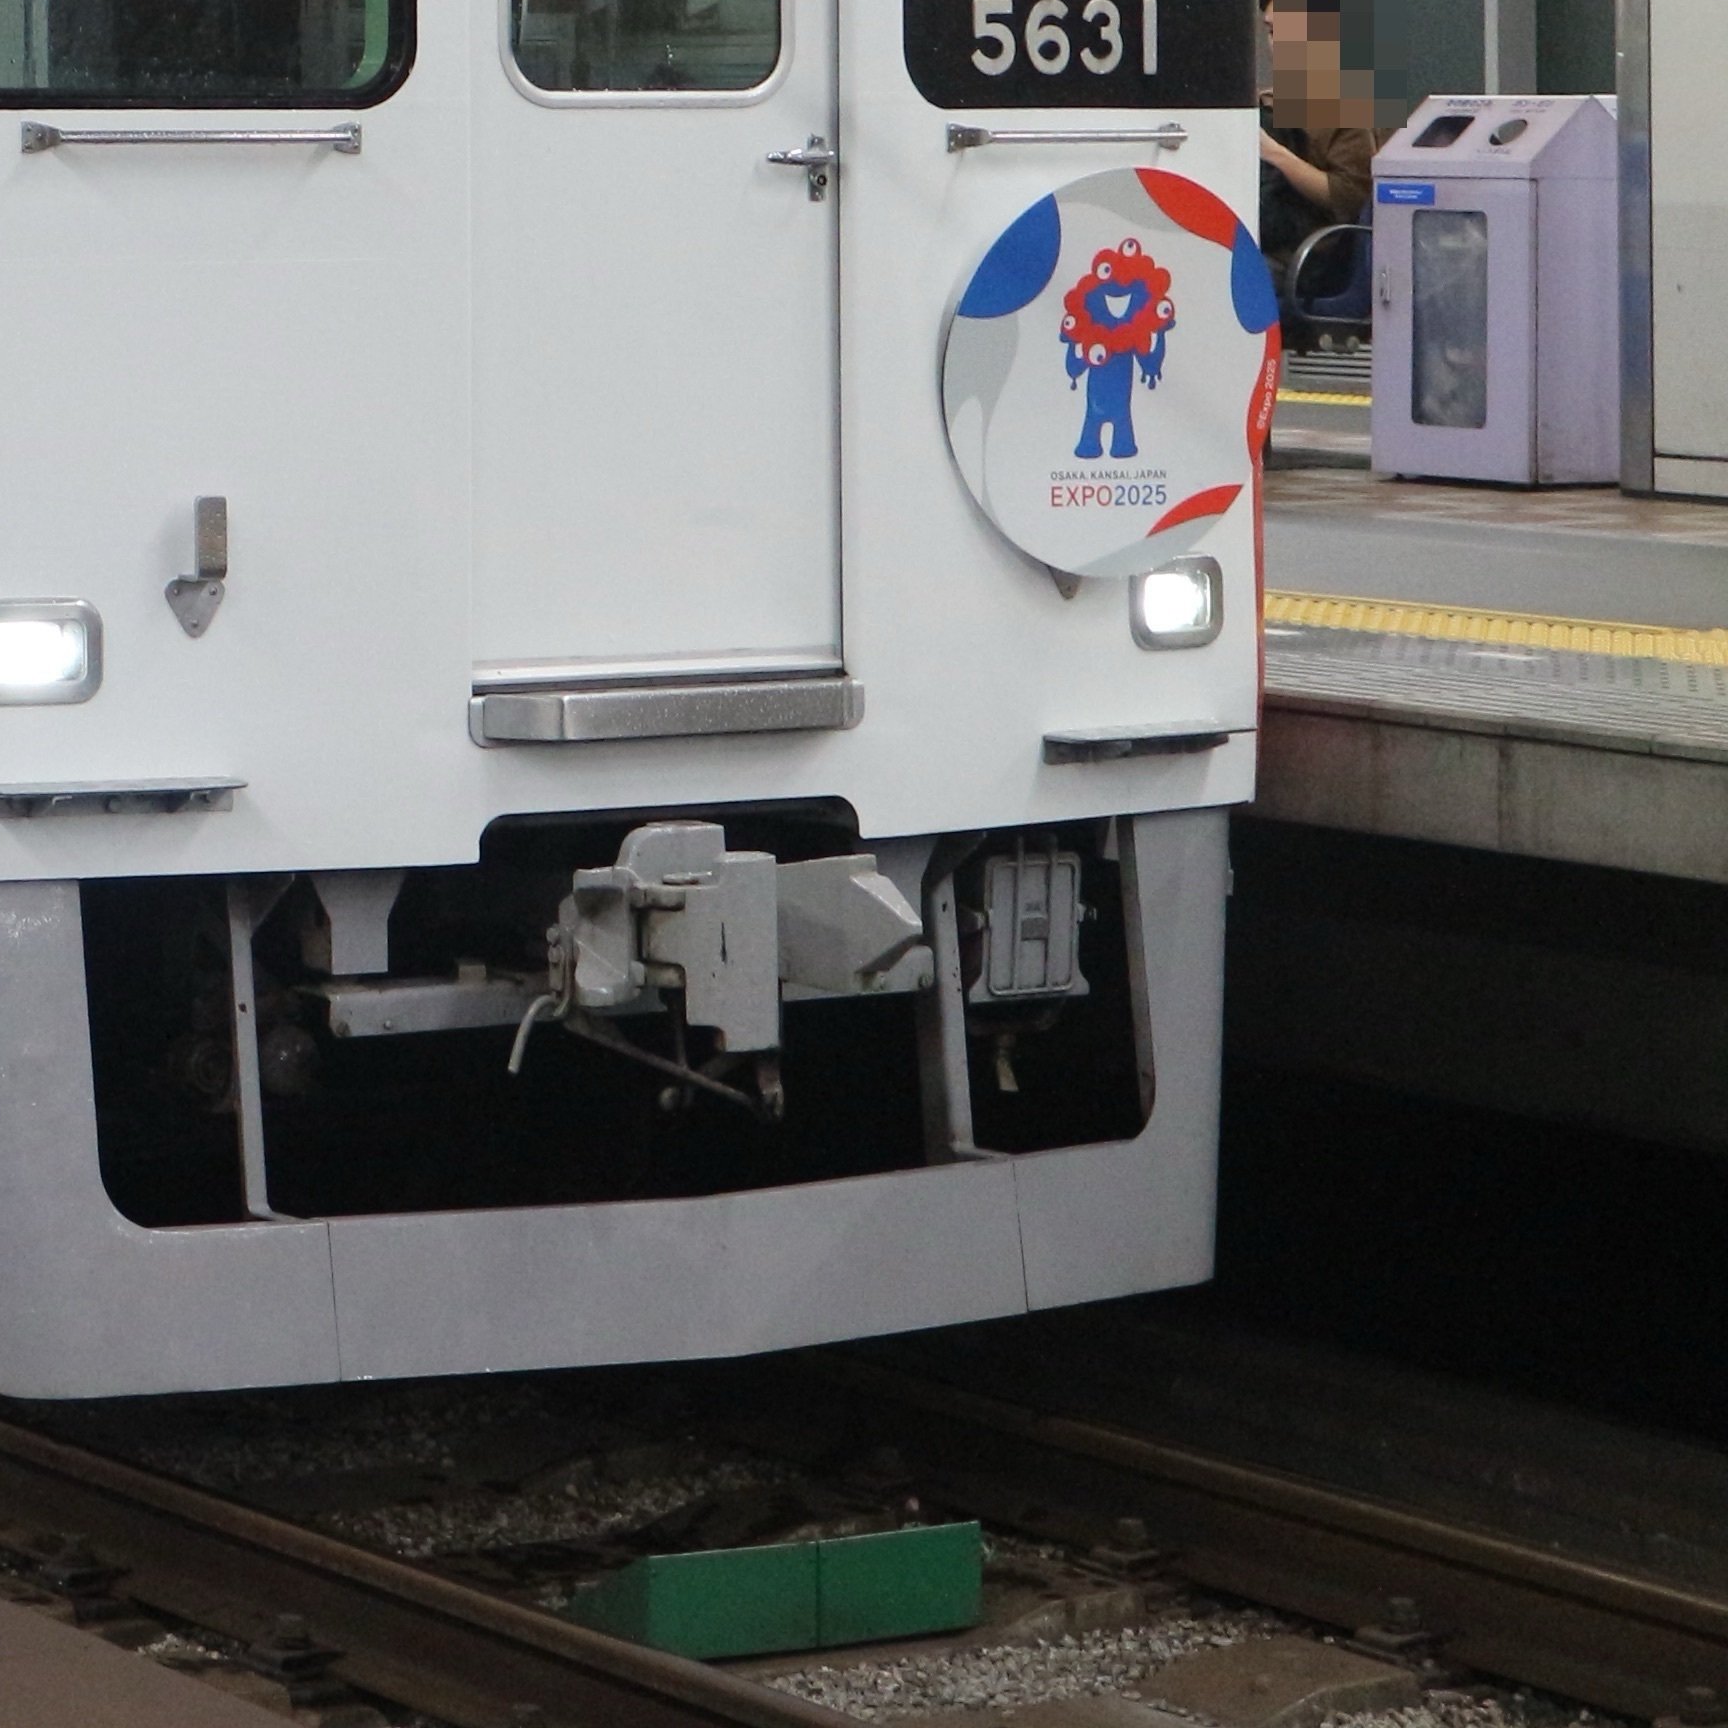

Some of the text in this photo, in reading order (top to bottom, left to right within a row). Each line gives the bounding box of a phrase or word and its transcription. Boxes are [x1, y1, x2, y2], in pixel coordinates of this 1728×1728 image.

[1264, 359, 1277, 389] 2025
[1134, 469, 1167, 479] JAPAN
[1051, 484, 1167, 507] EXPO2025
